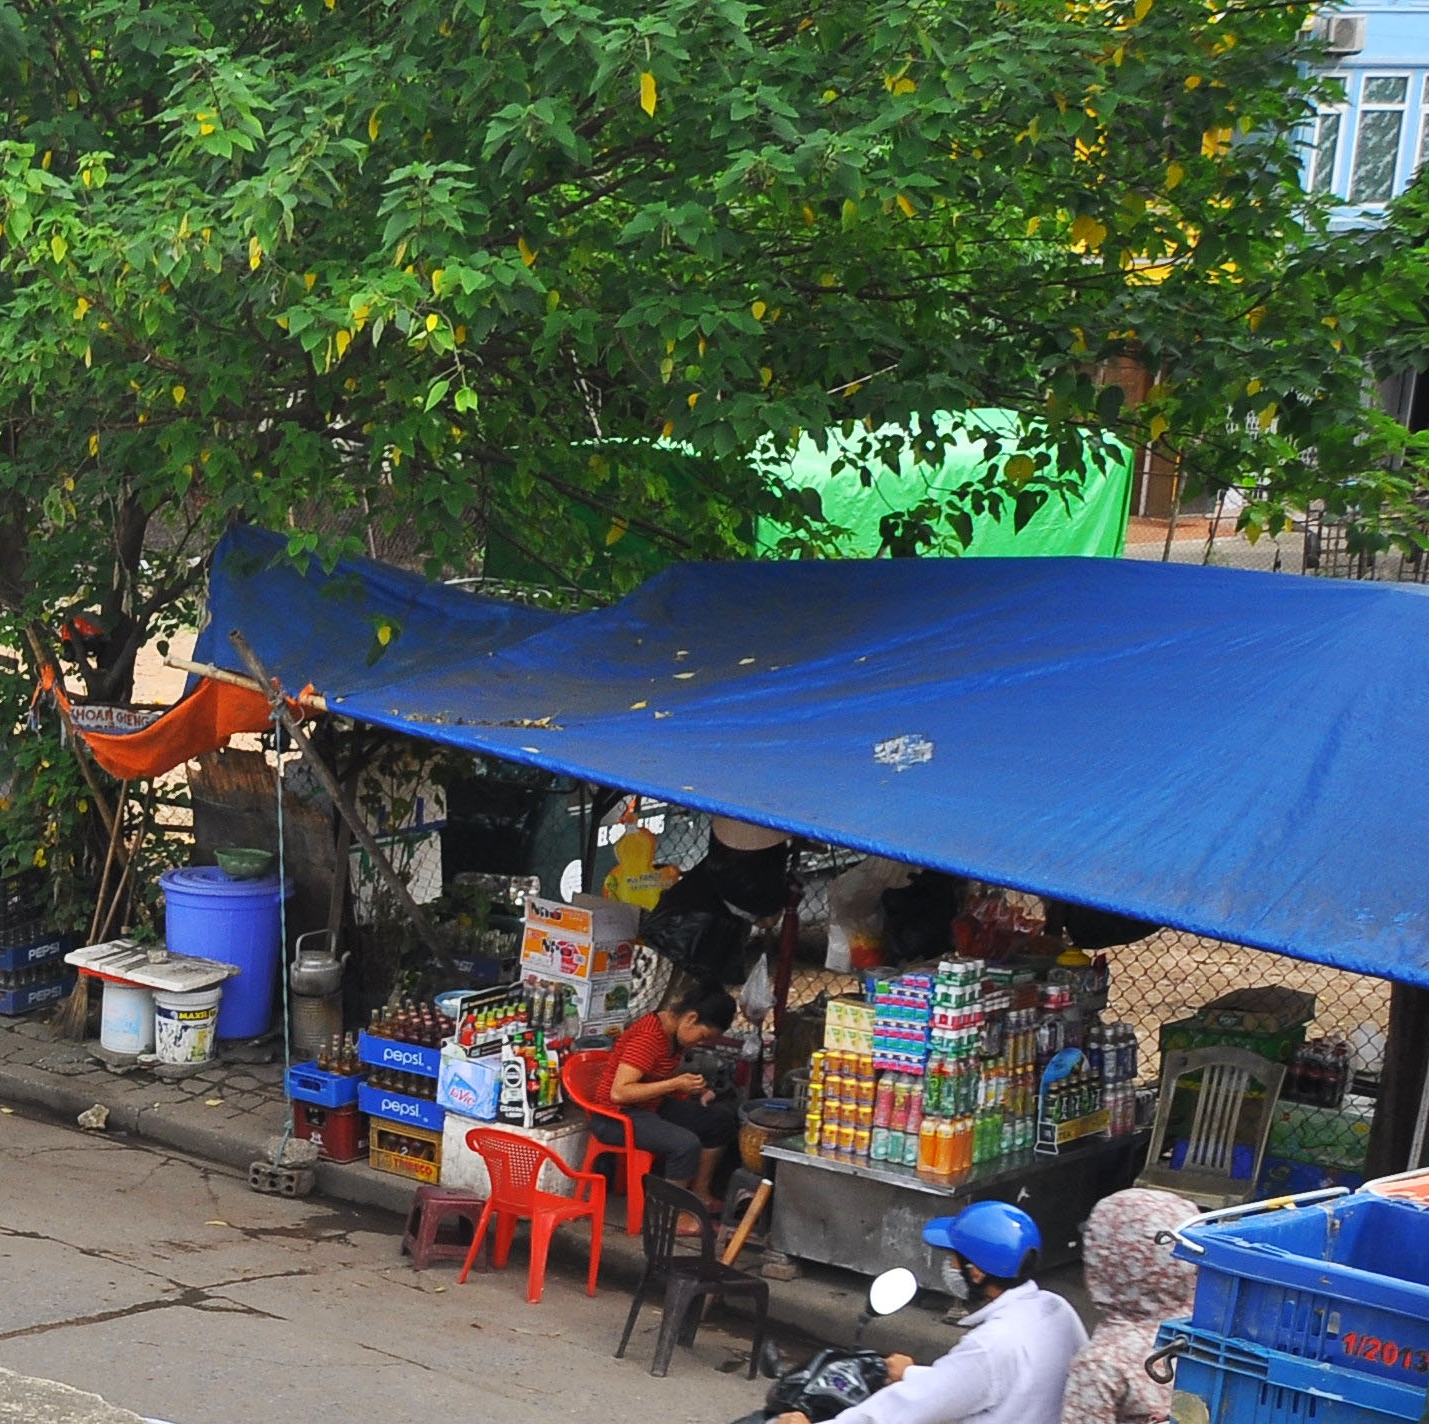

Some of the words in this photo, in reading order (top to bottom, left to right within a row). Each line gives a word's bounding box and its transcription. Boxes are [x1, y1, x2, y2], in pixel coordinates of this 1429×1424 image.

[28, 942, 60, 961] PEPSI
[28, 986, 62, 1004] PEPSI
[383, 1047, 422, 1066] pepsi
[382, 1098, 420, 1118] pepsi
